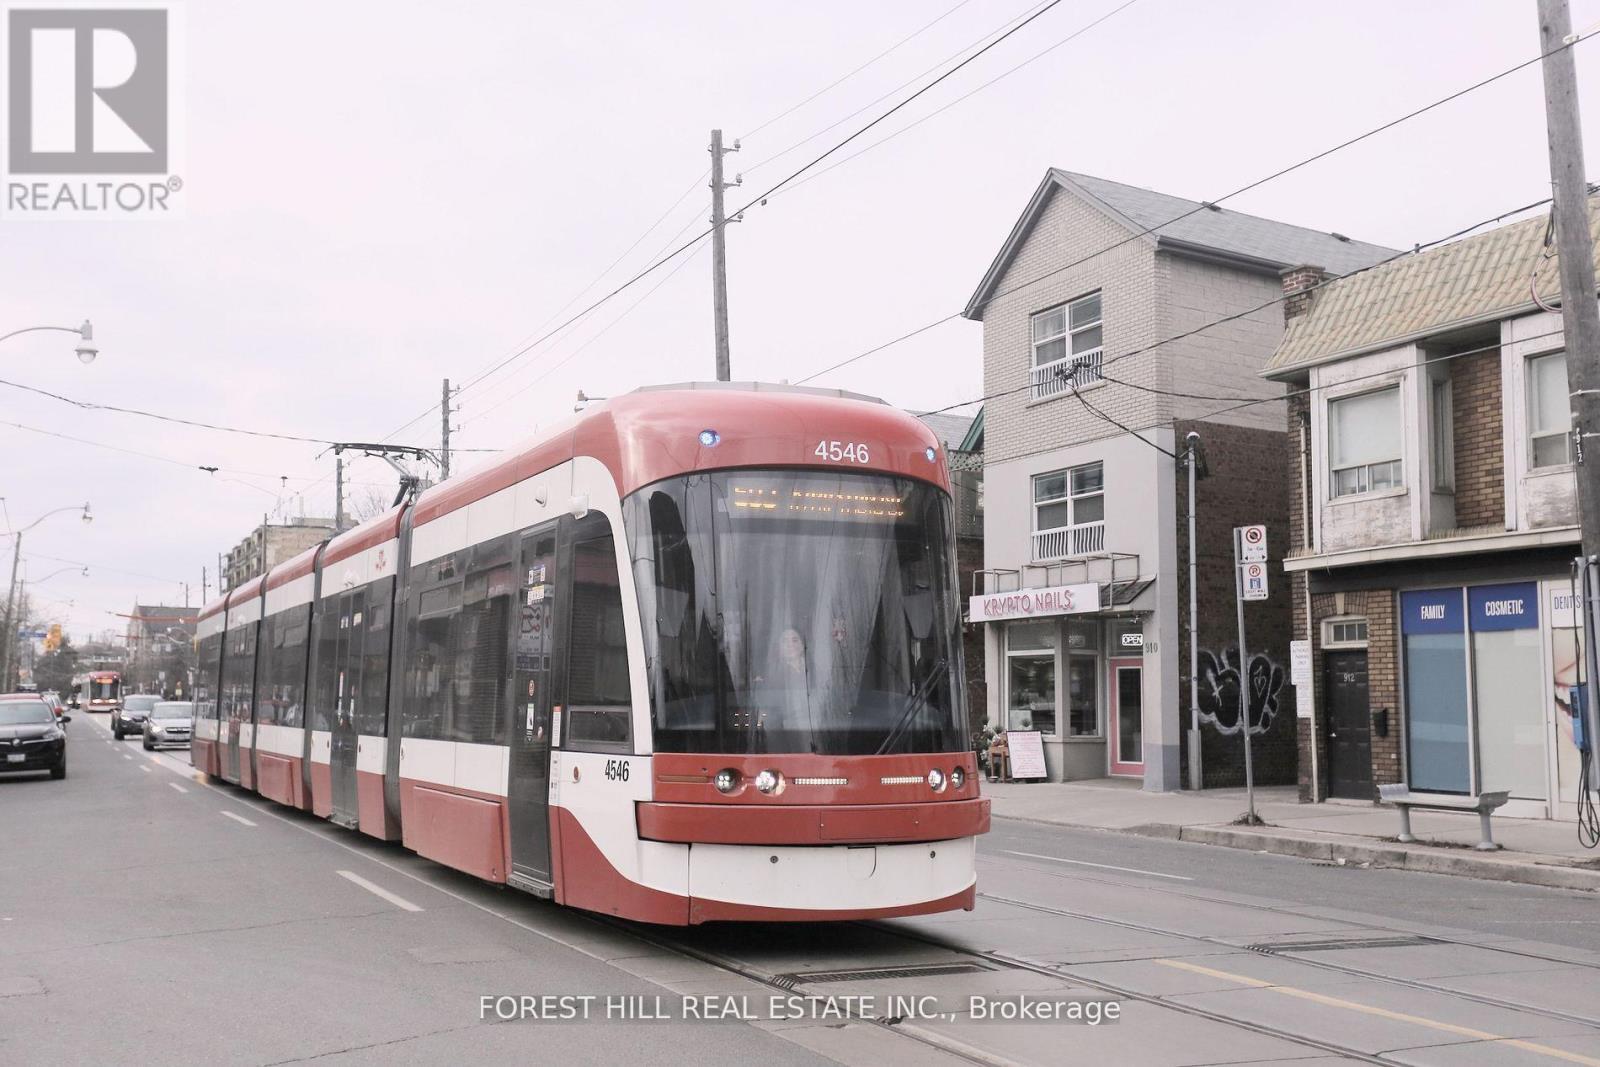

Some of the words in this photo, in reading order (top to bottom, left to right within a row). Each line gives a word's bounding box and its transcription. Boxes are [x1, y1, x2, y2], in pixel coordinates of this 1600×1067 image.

[814, 440, 870, 464] 4546
[983, 594, 1032, 617] KRYPTO
[1035, 589, 1075, 612] NAILS
[1485, 599, 1524, 616] COSMETIC
[1420, 604, 1445, 620] FAMILY
[1123, 635, 1143, 645] OPEN
[1145, 642, 1159, 654] 910
[1343, 672, 1355, 682] 912
[604, 759, 630, 782] 4546
